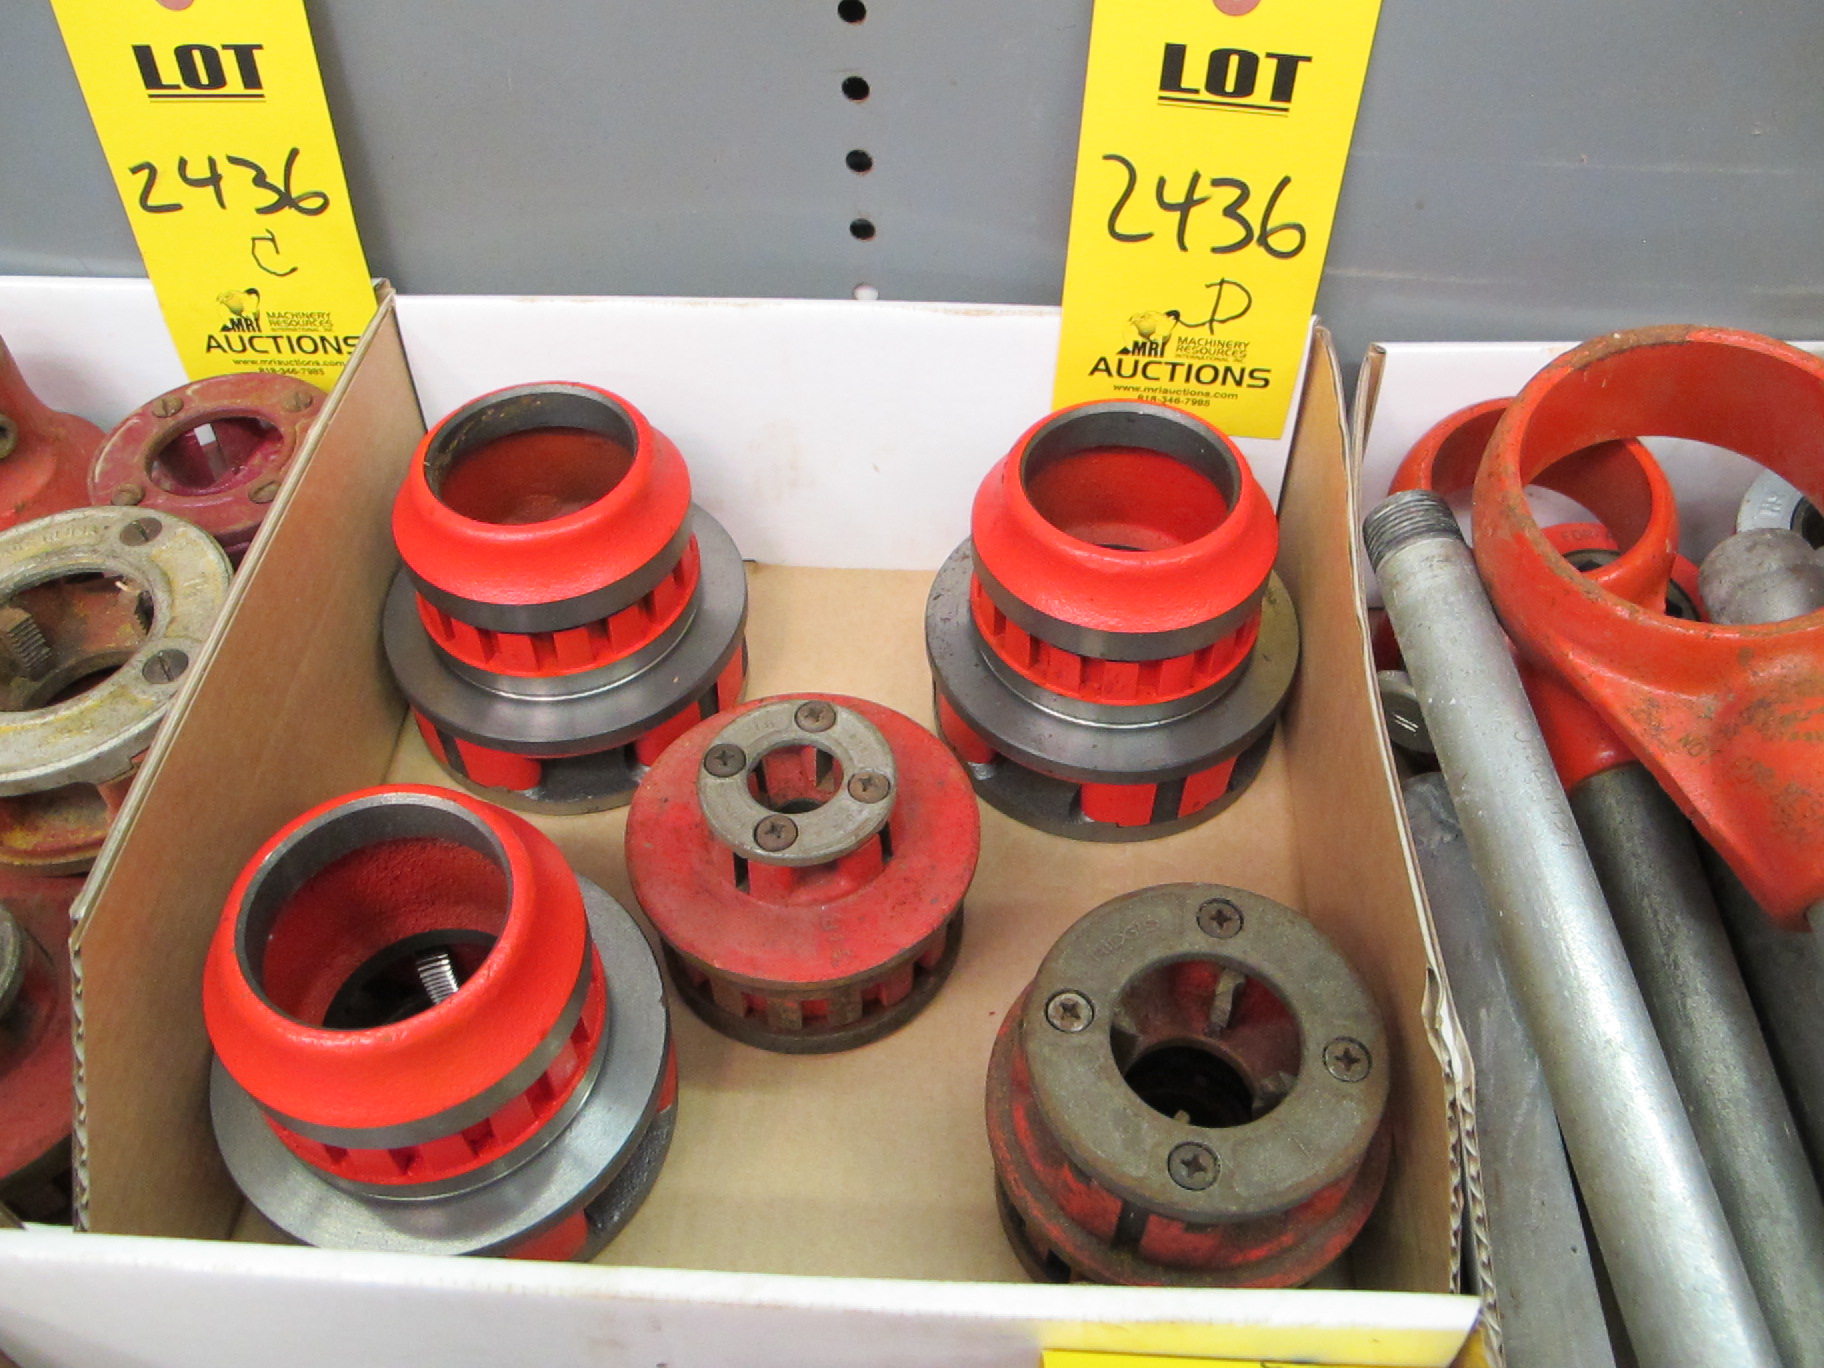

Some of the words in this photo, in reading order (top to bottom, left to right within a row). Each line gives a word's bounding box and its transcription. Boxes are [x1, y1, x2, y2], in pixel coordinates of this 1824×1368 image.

[131, 44, 265, 90] LOT
[1159, 42, 1313, 103] LOT
[128, 147, 330, 215] 2436
[1102, 154, 1307, 260] 2436
[251, 228, 298, 276] C
[229, 316, 263, 332] MRI
[205, 334, 361, 355] AUCTIONS
[1131, 339, 1166, 359] MRI
[1175, 345, 1248, 359] RESOURCES
[1177, 336, 1250, 350] MACHINERY
[1088, 356, 1272, 389] AUCTIONS
[1113, 384, 1239, 400] www.mriauctions.com
